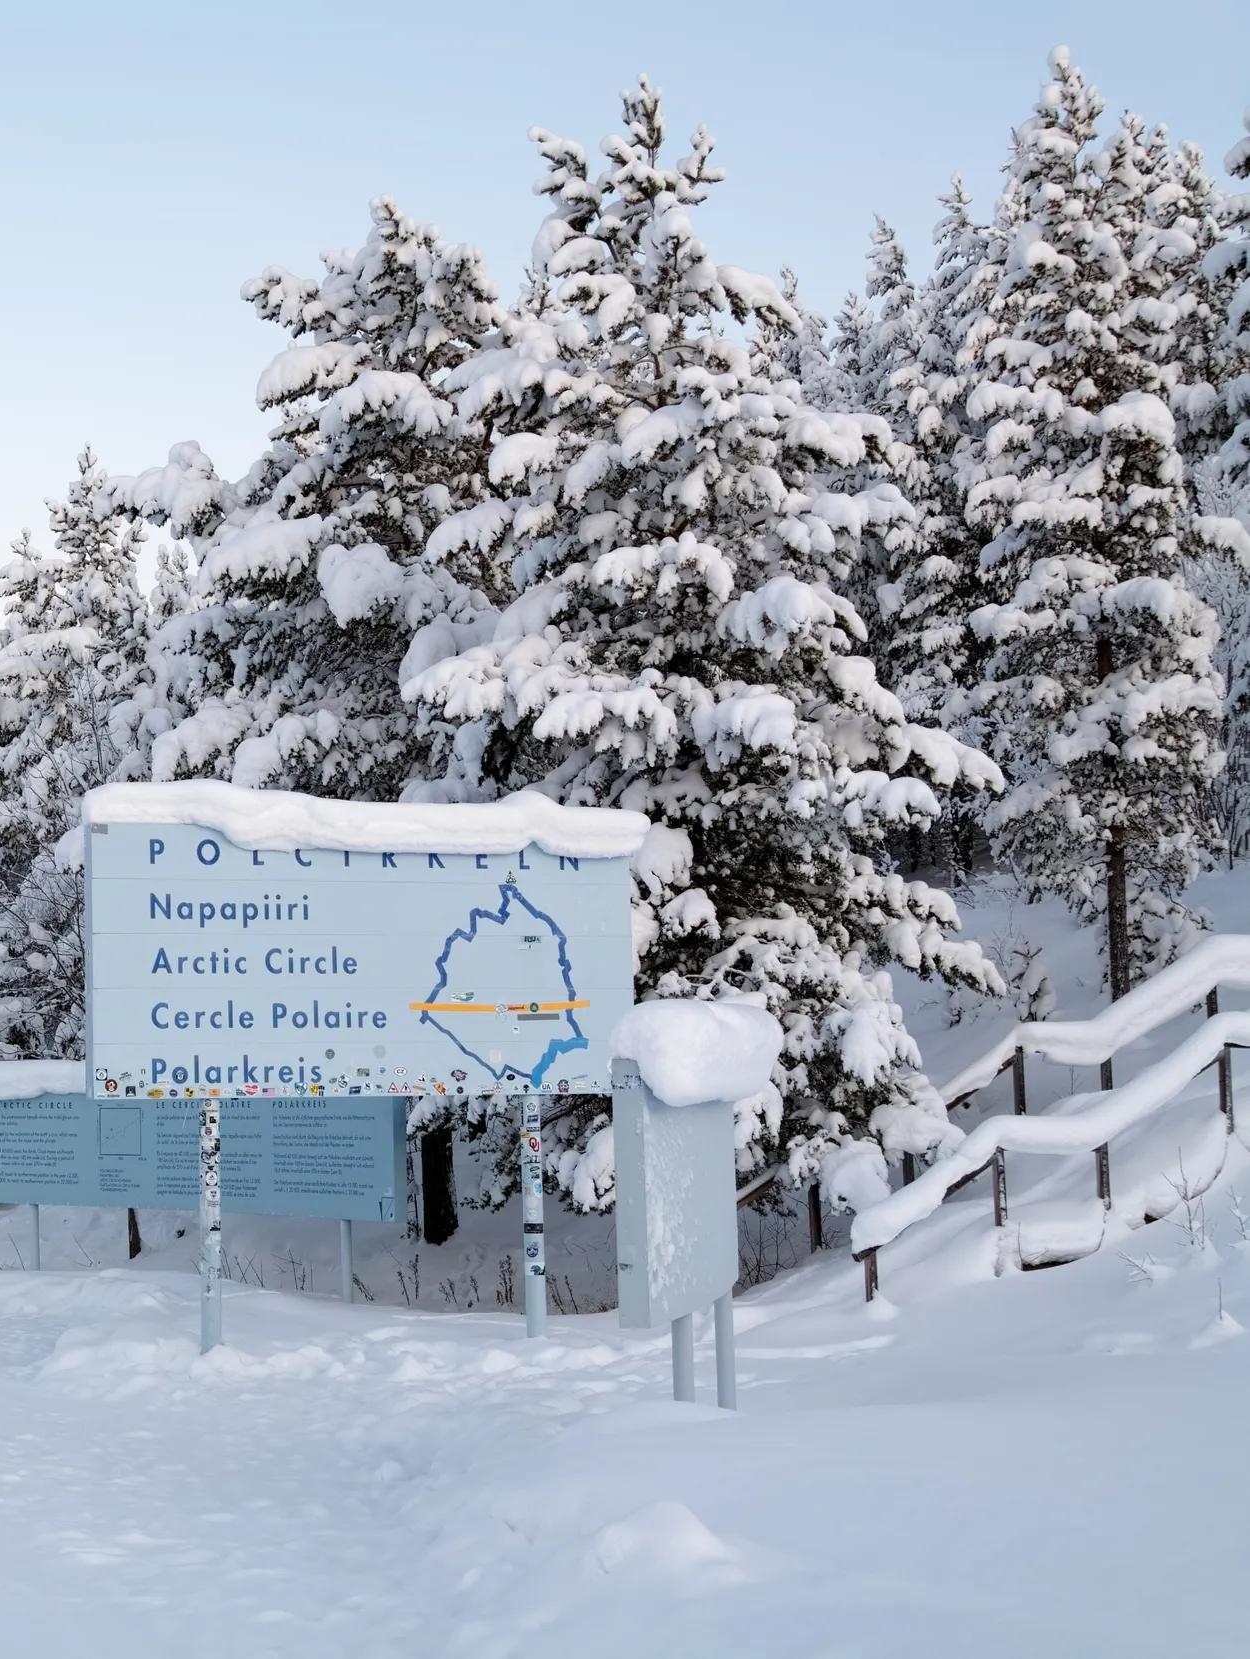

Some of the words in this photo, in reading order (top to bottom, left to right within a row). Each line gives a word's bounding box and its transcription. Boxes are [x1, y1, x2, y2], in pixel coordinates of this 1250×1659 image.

[149, 894, 310, 928] Napapiiri
[151, 947, 248, 975] Arctic
[264, 946, 359, 975] Circle
[151, 999, 255, 1030] Cercle
[272, 998, 388, 1029] Polaire
[151, 1054, 323, 1085] Polarkreis
[542, 1083, 551, 1091] UA
[38, 1102, 73, 1110] CIRCLE
[156, 1101, 165, 1109] LE
[172, 1101, 200, 1109] CERCL
[218, 1101, 251, 1109] OLAIRE
[272, 1100, 327, 1109] POLARKREIS
